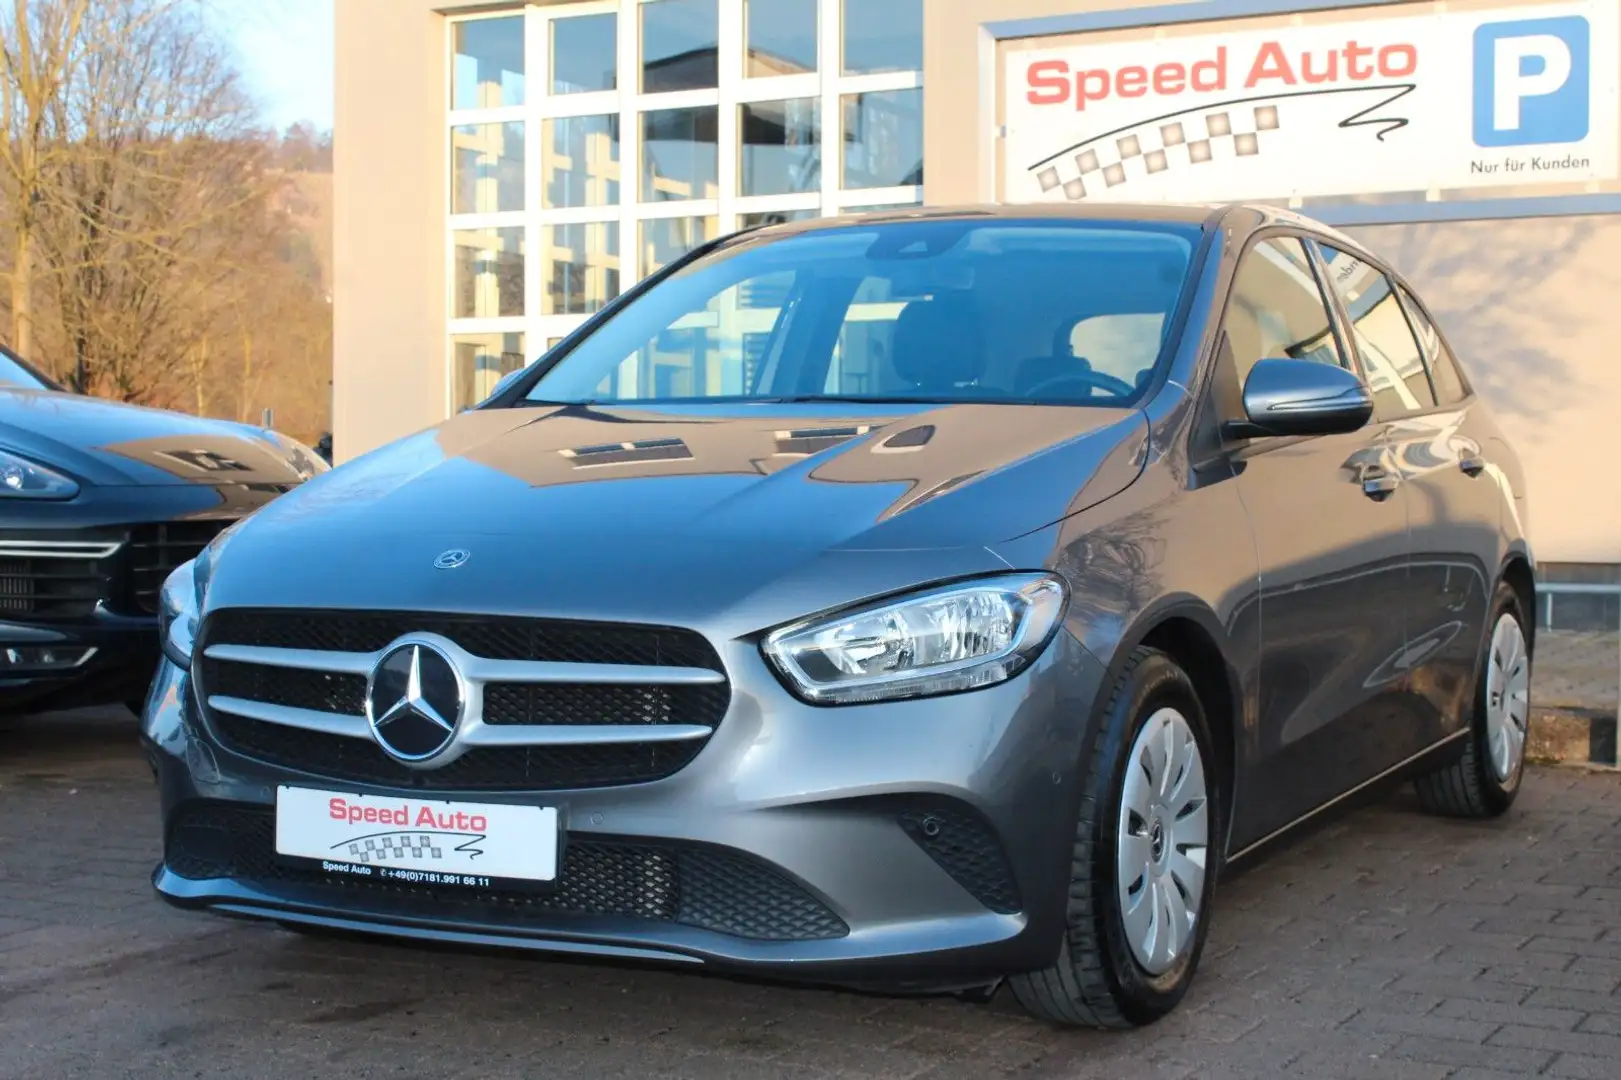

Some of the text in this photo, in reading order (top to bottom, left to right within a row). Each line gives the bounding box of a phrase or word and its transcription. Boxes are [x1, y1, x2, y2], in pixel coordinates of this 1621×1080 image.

[1026, 41, 1418, 111] Speed Auto
[1493, 34, 1572, 131] P
[1471, 153, 1590, 174] Nur für Kunden
[329, 798, 487, 832] Speed Auto
[322, 861, 490, 887] Speed Auto +49(0)7181.991 66 11
